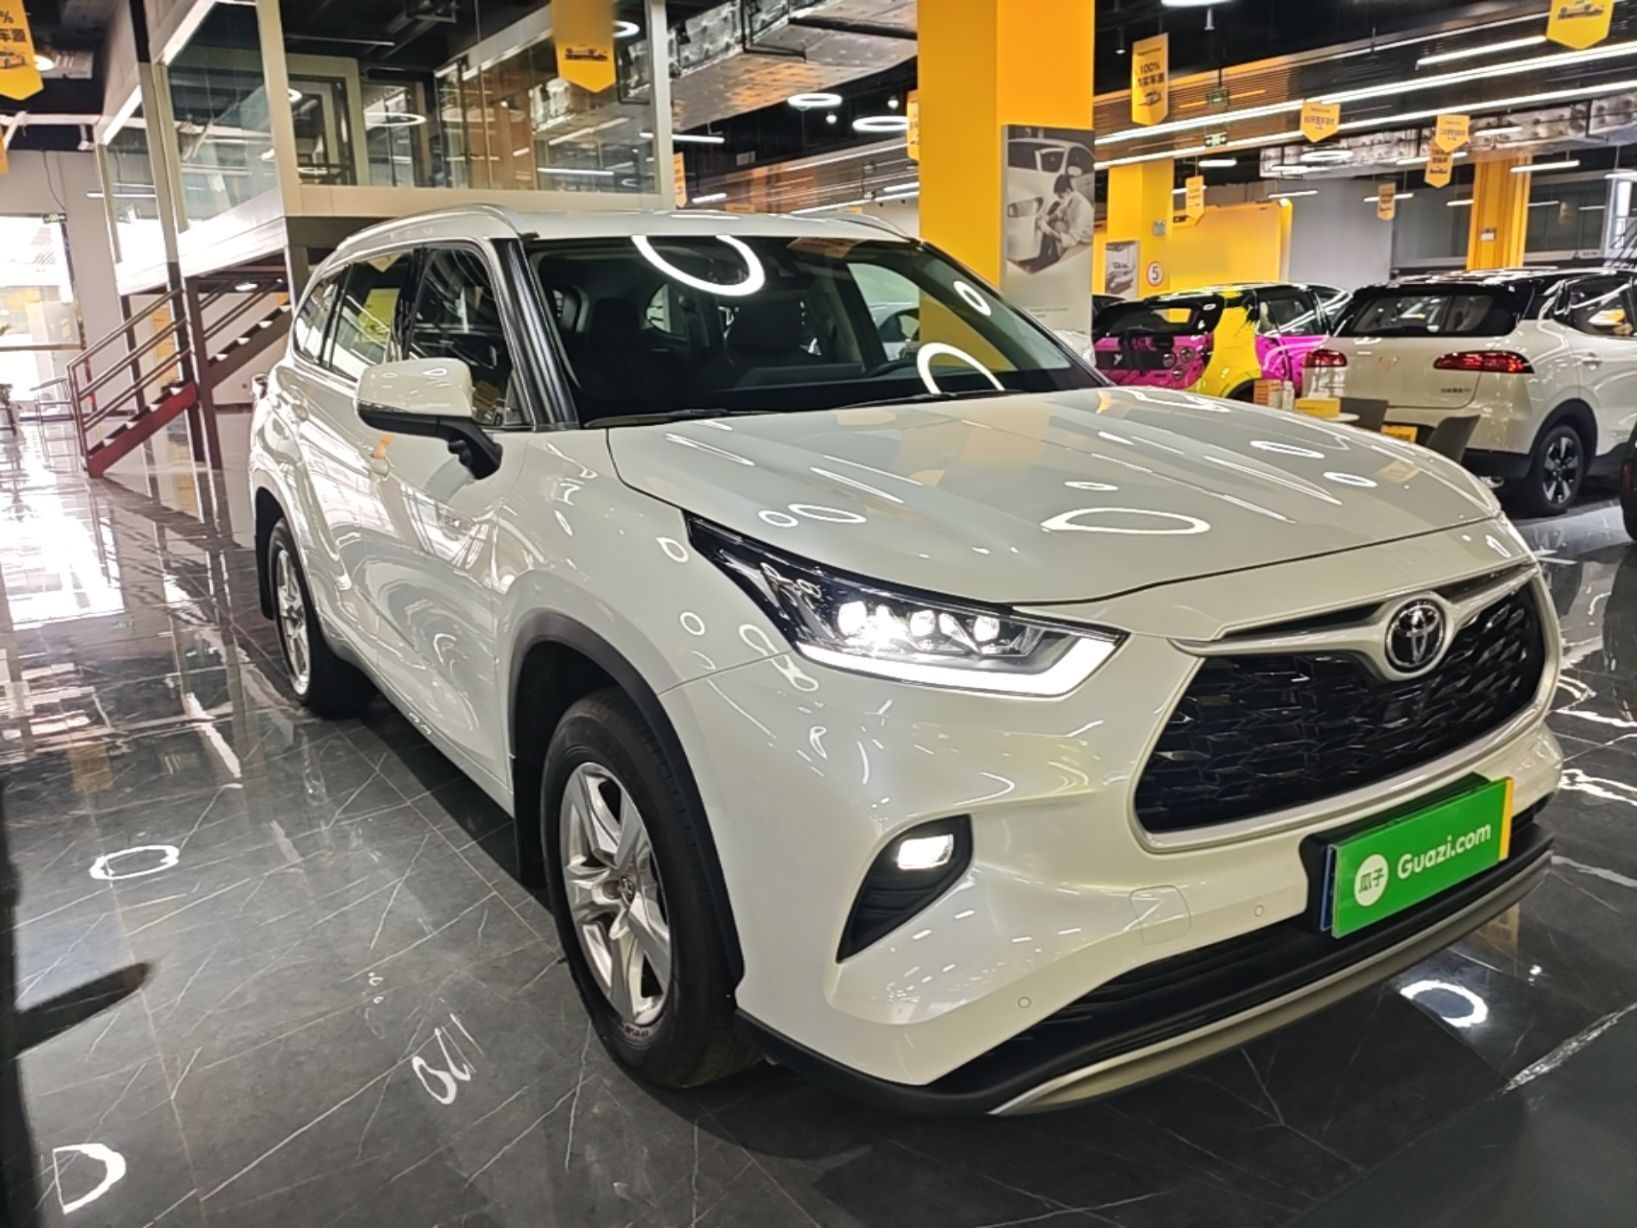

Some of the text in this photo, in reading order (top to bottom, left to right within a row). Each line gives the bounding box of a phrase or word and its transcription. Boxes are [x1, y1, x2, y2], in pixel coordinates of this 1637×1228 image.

[1140, 62, 1161, 75] 100%
[1152, 265, 1159, 281] 5
[1397, 823, 1491, 880] Guazi.com
[1358, 865, 1385, 894] 瓜子
